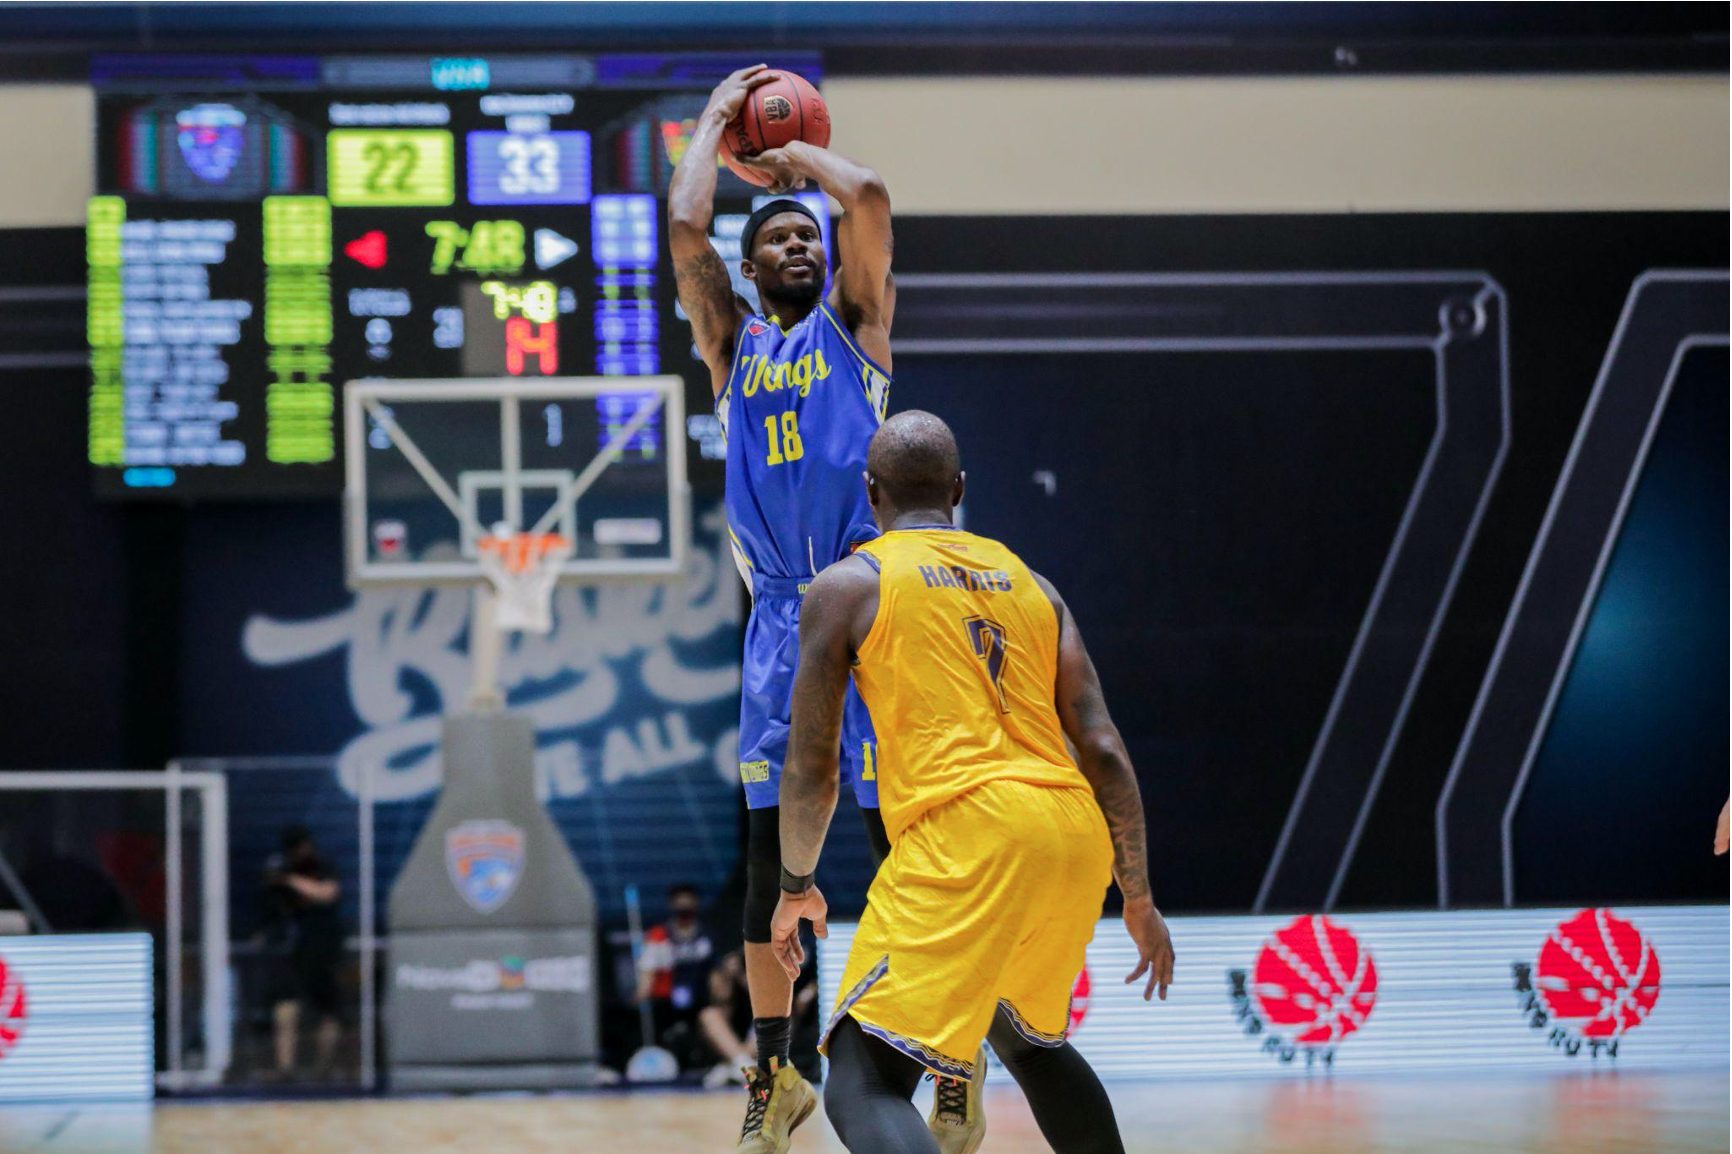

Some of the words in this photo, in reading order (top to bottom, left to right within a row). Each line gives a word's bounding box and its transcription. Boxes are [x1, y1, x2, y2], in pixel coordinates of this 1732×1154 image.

[361, 140, 419, 193] 22
[499, 137, 560, 194] 33
[425, 220, 526, 275] 7:48
[741, 349, 832, 397] Wings
[764, 410, 804, 466] 18
[918, 565, 1013, 592] HARRIS
[962, 614, 1011, 715] 7
